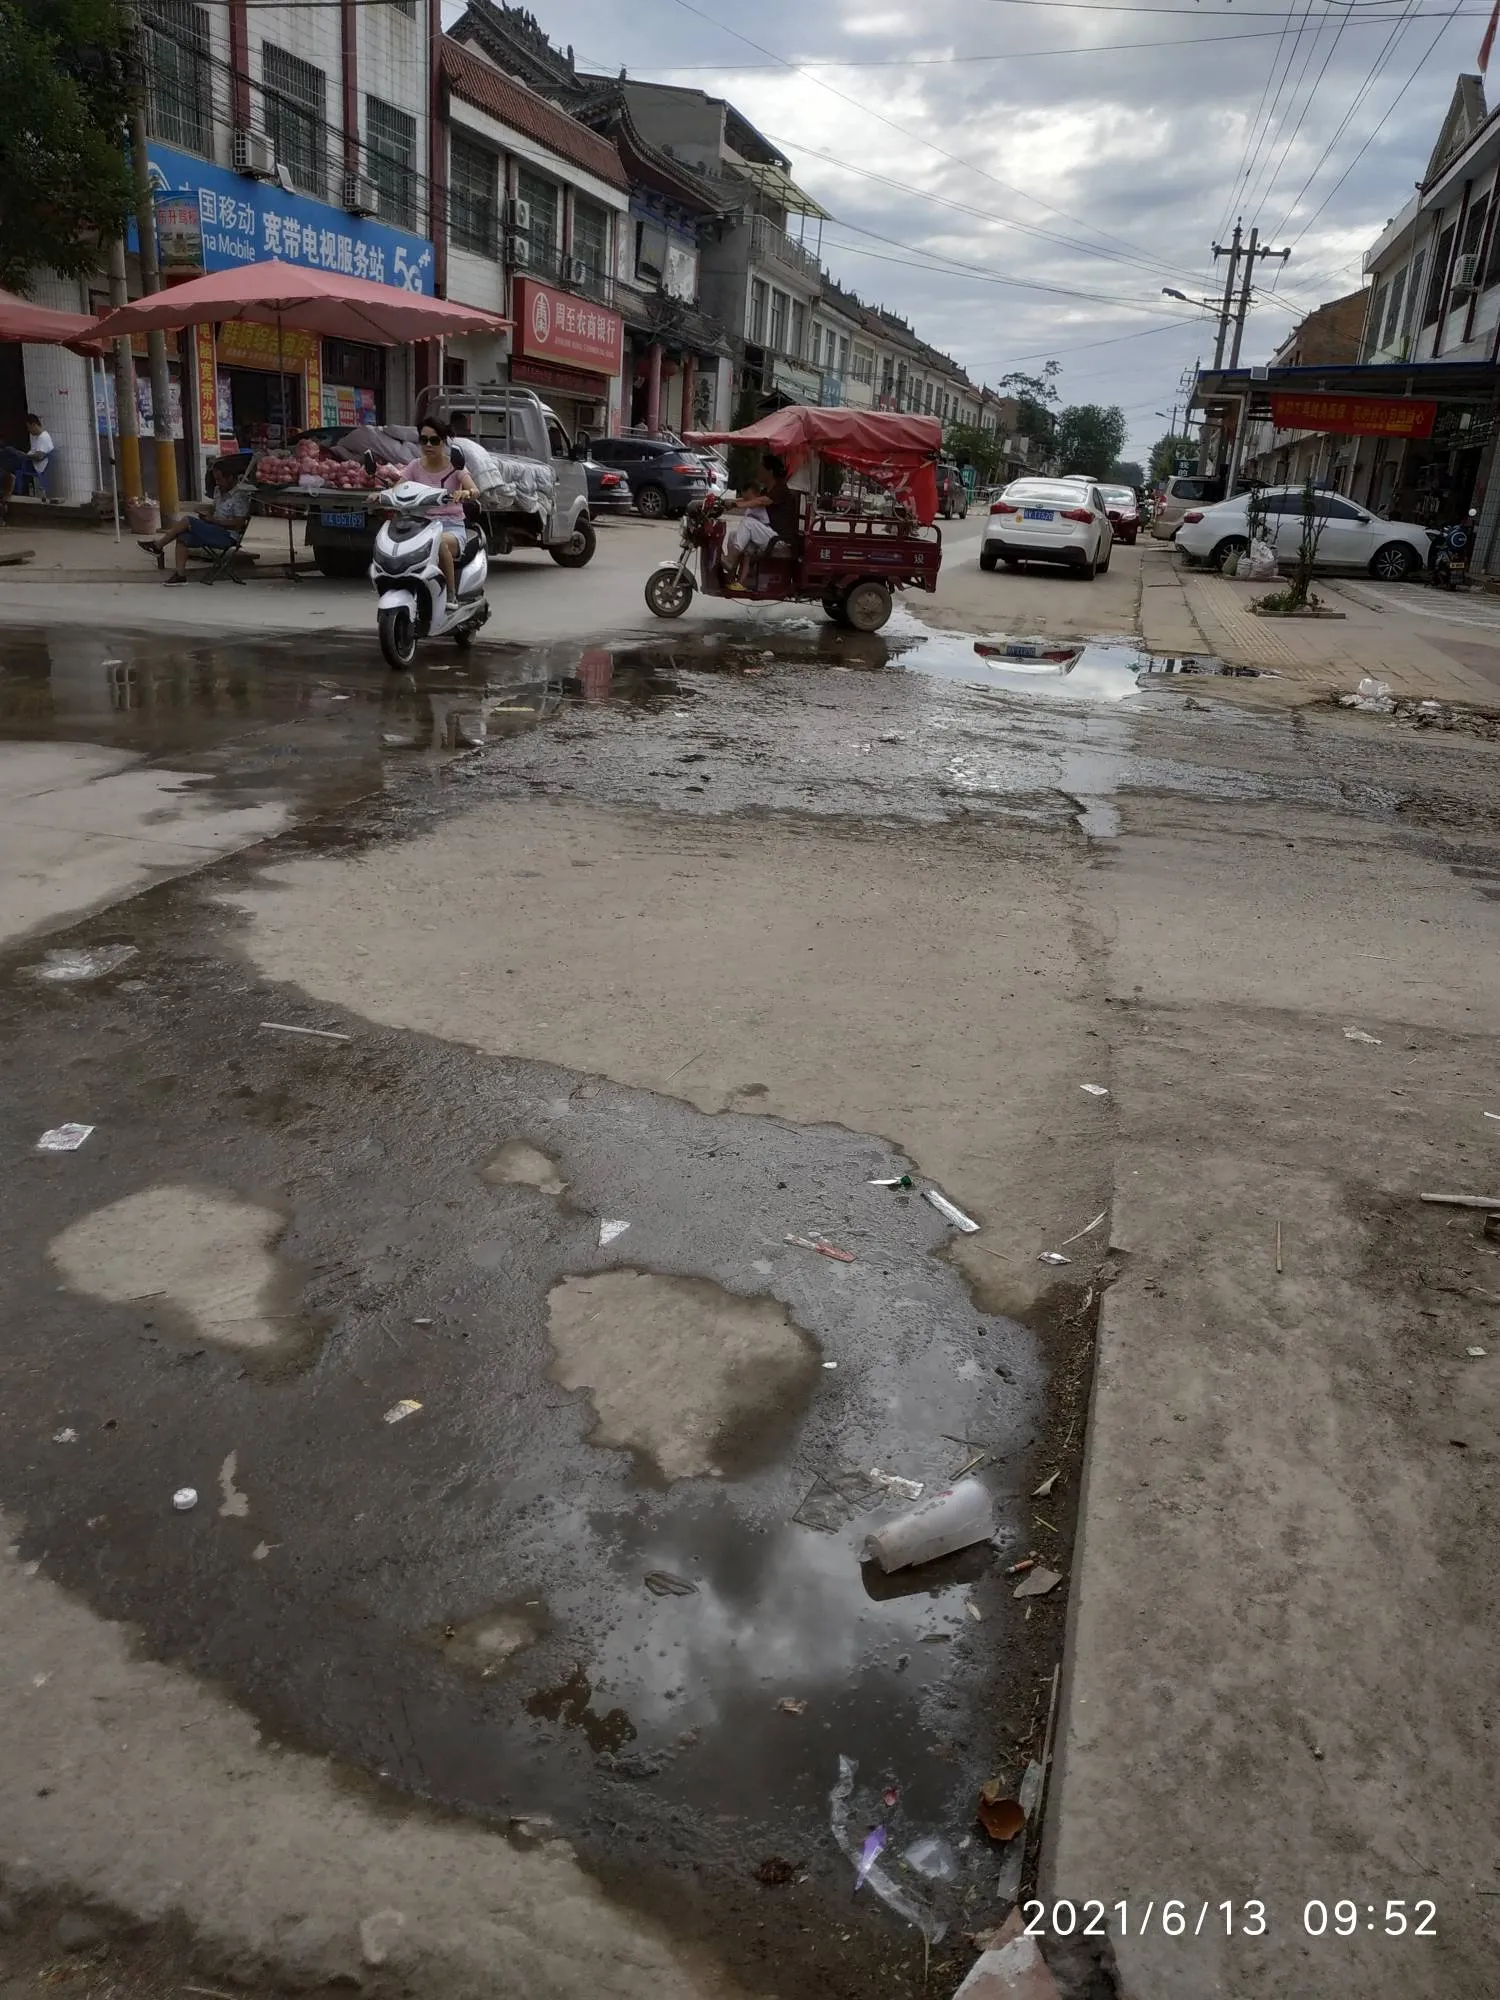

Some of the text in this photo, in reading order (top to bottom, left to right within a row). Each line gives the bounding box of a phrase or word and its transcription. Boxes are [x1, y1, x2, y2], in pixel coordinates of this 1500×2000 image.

[219, 233, 256, 261] Mobile
[262, 211, 385, 284] 宽带电视服务站
[554, 301, 616, 344] 周至农商银行
